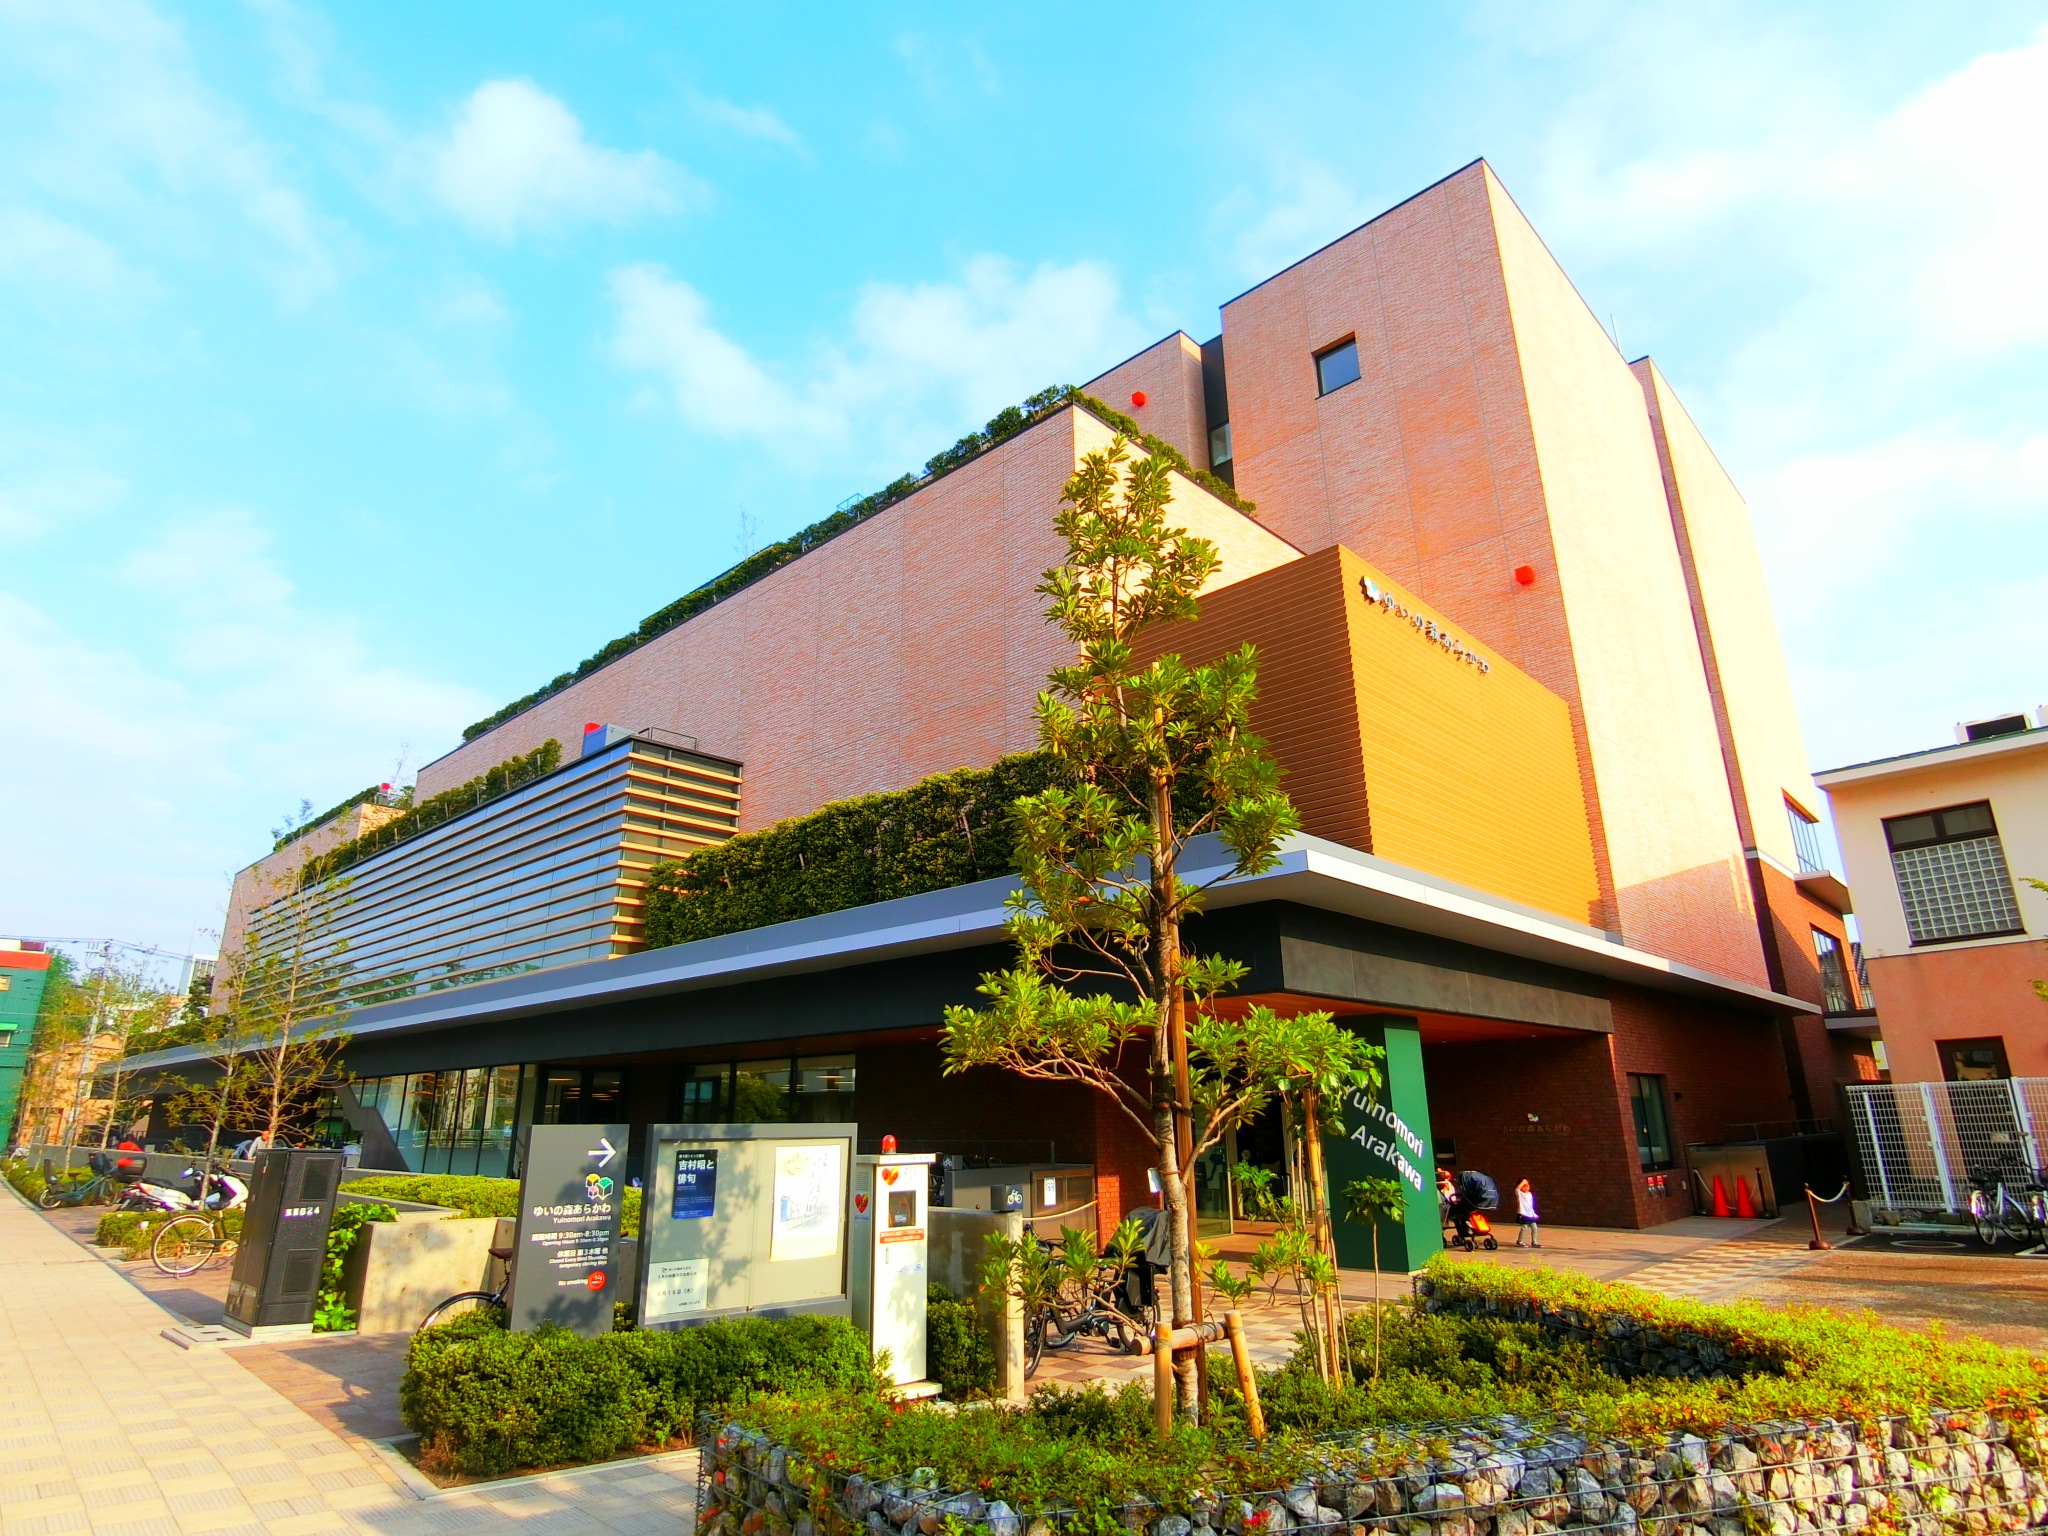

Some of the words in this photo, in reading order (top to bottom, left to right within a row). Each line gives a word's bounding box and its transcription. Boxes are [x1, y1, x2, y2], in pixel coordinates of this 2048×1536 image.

[1350, 1124, 1422, 1192] Arakawa
[678, 1160, 715, 1171] 吉村昭と
[677, 1173, 697, 1185] 俳句
[533, 1203, 612, 1217] ゆいの森あらかわ
